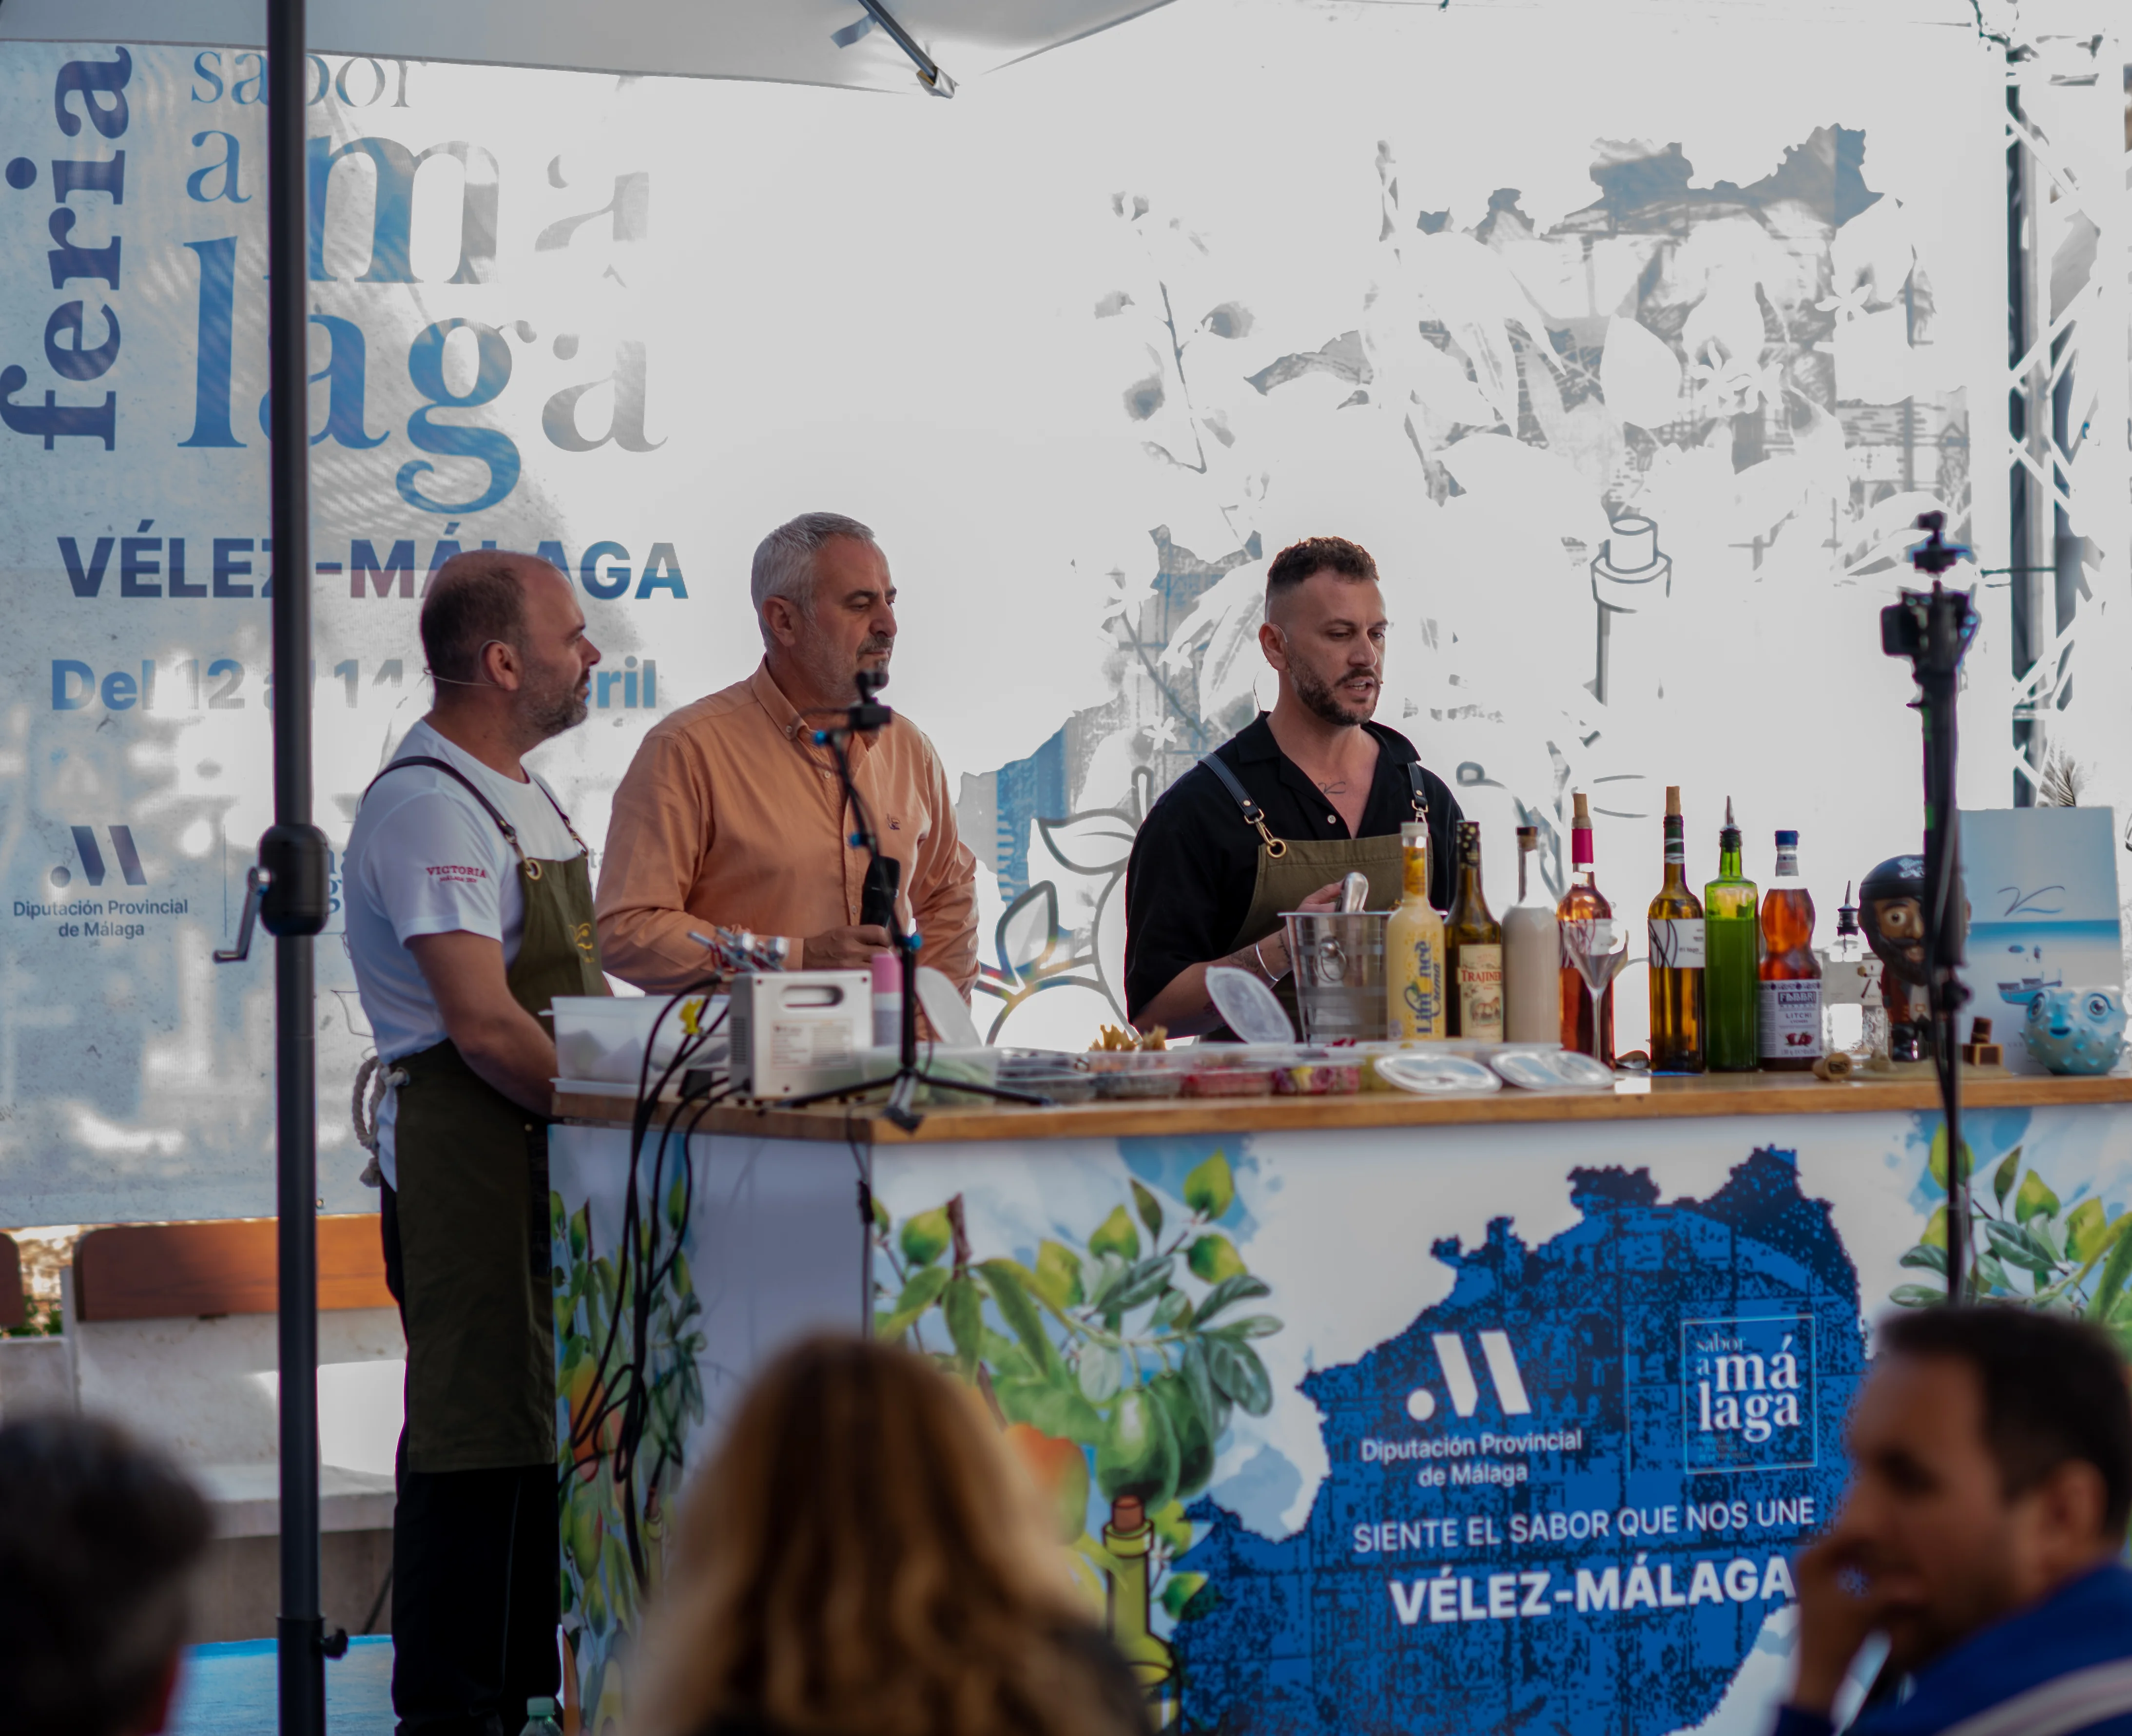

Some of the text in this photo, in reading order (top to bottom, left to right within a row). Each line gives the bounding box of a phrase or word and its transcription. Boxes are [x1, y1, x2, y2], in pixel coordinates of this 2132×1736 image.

[186, 130, 252, 204] a
[0, 46, 132, 451] feria
[177, 235, 668, 513] laga
[57, 519, 689, 599] VÉLE-MÁGA
[52, 659, 156, 711] Del
[584, 656, 657, 709] ril
[425, 865, 486, 878] VICTORIA
[13, 899, 188, 920] Diputación Provincial
[58, 920, 145, 939] de Málaga
[1414, 941, 1432, 1035] Limncé
[1780, 992, 1815, 1002] FABBRI
[1696, 1331, 1746, 1352] sabor
[1696, 1333, 1802, 1392] a má
[1698, 1380, 1803, 1443] laga
[1361, 1428, 1582, 1465] Diputación Provincial
[1418, 1461, 1528, 1487] de Málaga
[1353, 1495, 1815, 1553] SIENTE EL SABOR QUE NOS UNE
[1389, 1550, 1797, 1625] VÉLEZ-MÁLAGA
